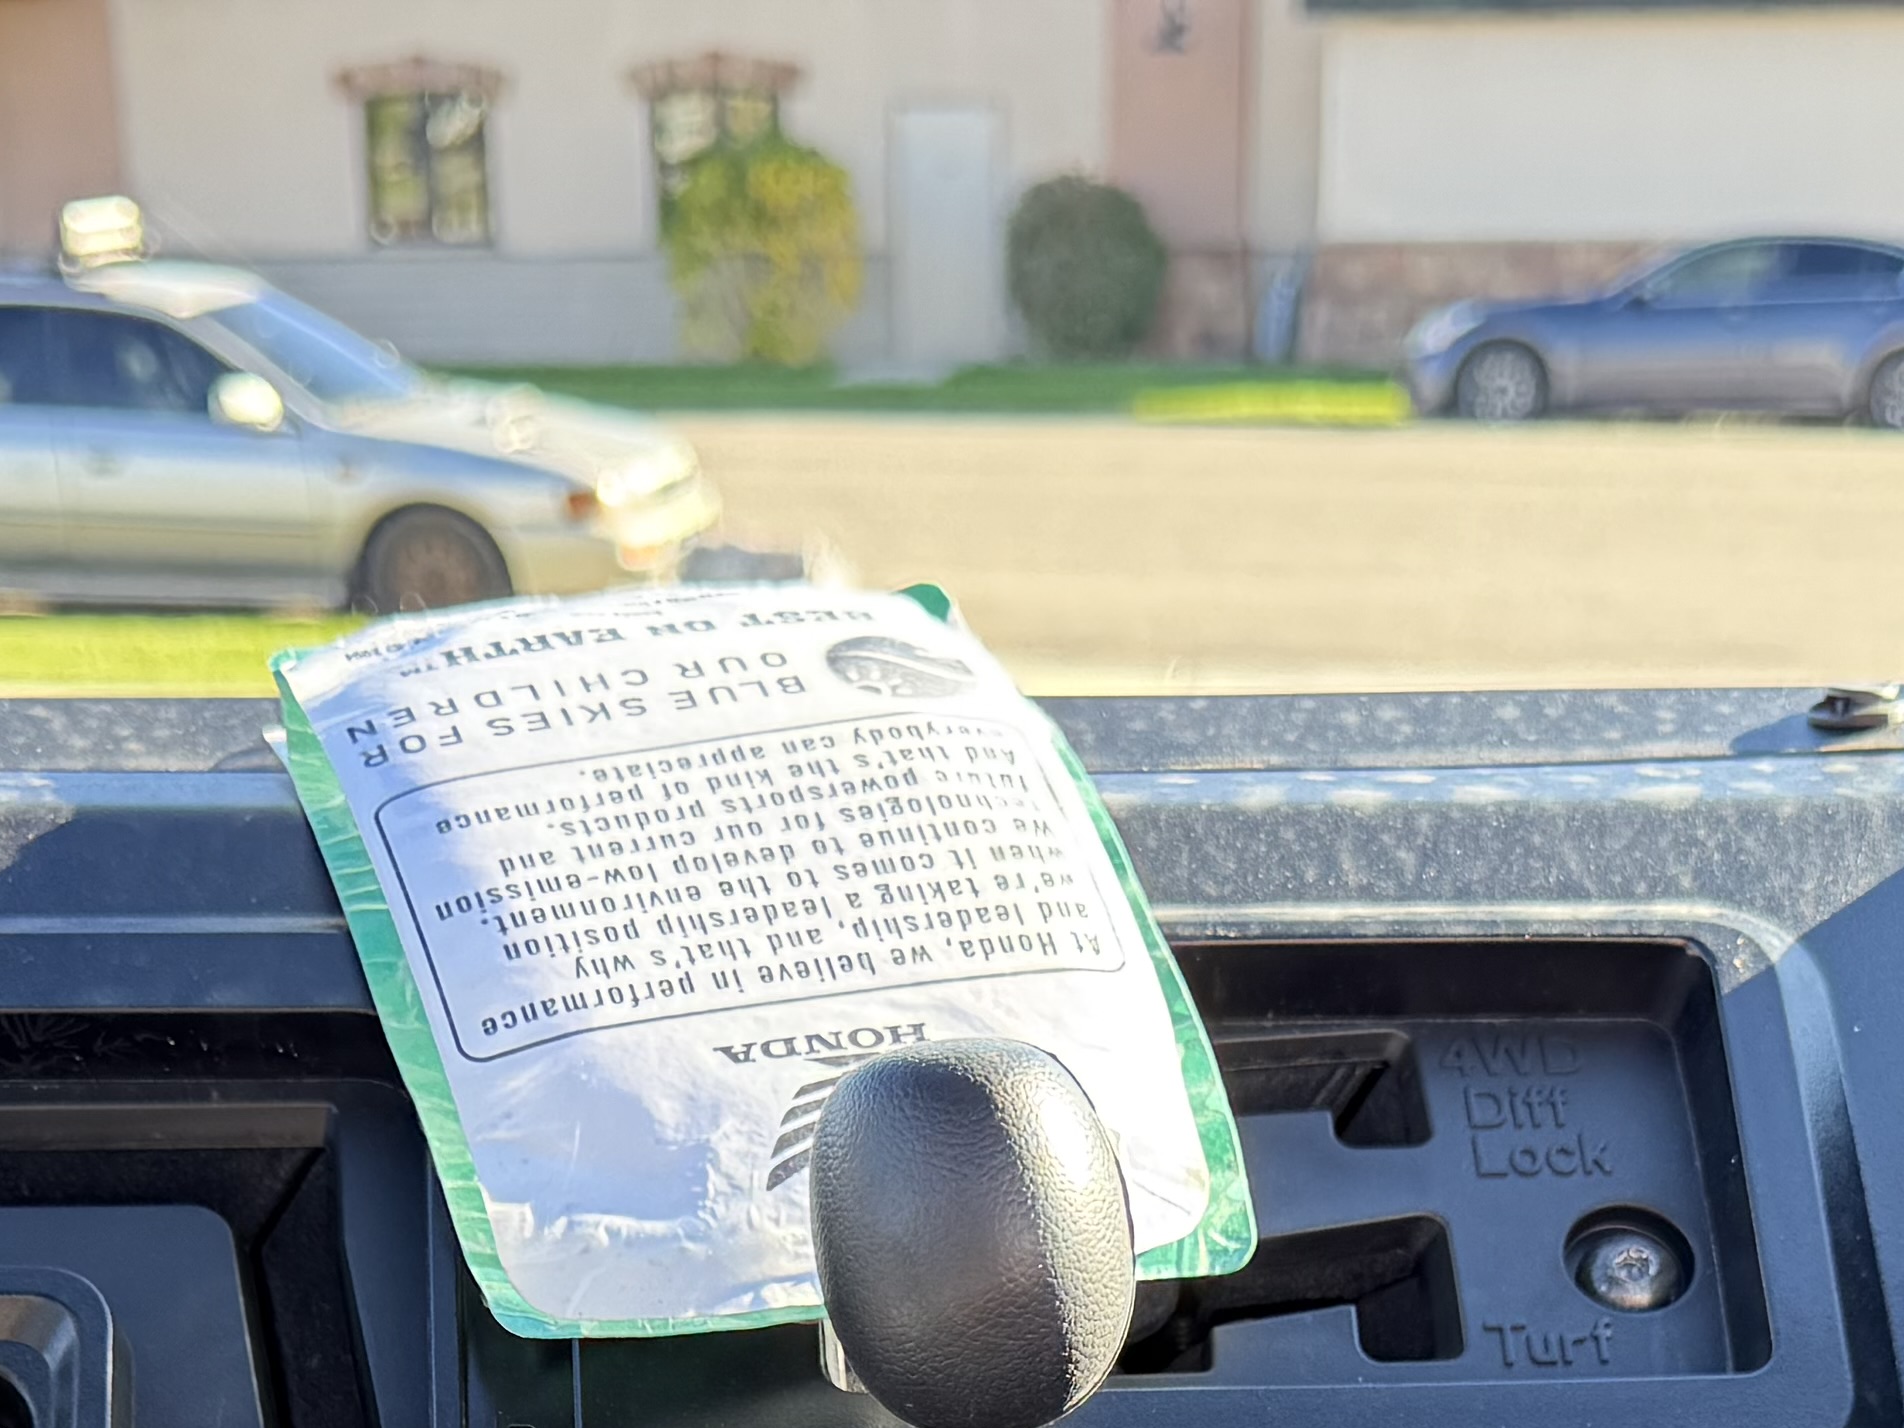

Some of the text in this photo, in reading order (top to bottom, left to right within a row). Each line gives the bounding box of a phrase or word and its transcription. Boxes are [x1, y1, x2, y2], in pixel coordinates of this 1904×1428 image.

[345, 651, 788, 745] OUR CHILDREN
[358, 675, 806, 768] BLUE SKIES FOR
[580, 745, 765, 783] appreciate.
[781, 734, 835, 758] can
[435, 746, 1015, 835] And that's the kind of performance
[722, 768, 918, 814] powersports
[546, 799, 705, 838] products.
[712, 820, 762, 844] our
[780, 811, 825, 834] for
[858, 818, 996, 850] continue
[498, 850, 555, 877] and
[571, 831, 695, 863] current
[672, 843, 795, 876] develop
[811, 838, 844, 858] to
[434, 862, 657, 923] low-emission
[480, 844, 1063, 936] when it comes to the environment.
[502, 872, 1073, 963] we're taking a leadership position
[574, 901, 1088, 982] and leadership, and that's why
[480, 931, 1101, 1040] At Honda, we believe in performance
[712, 1023, 927, 1064] HONDA
[1438, 1034, 1582, 1078] 4WD
[1464, 1086, 1569, 1130] Diff
[1473, 1134, 1612, 1178] Lock
[1484, 1320, 1615, 1368] Turf
